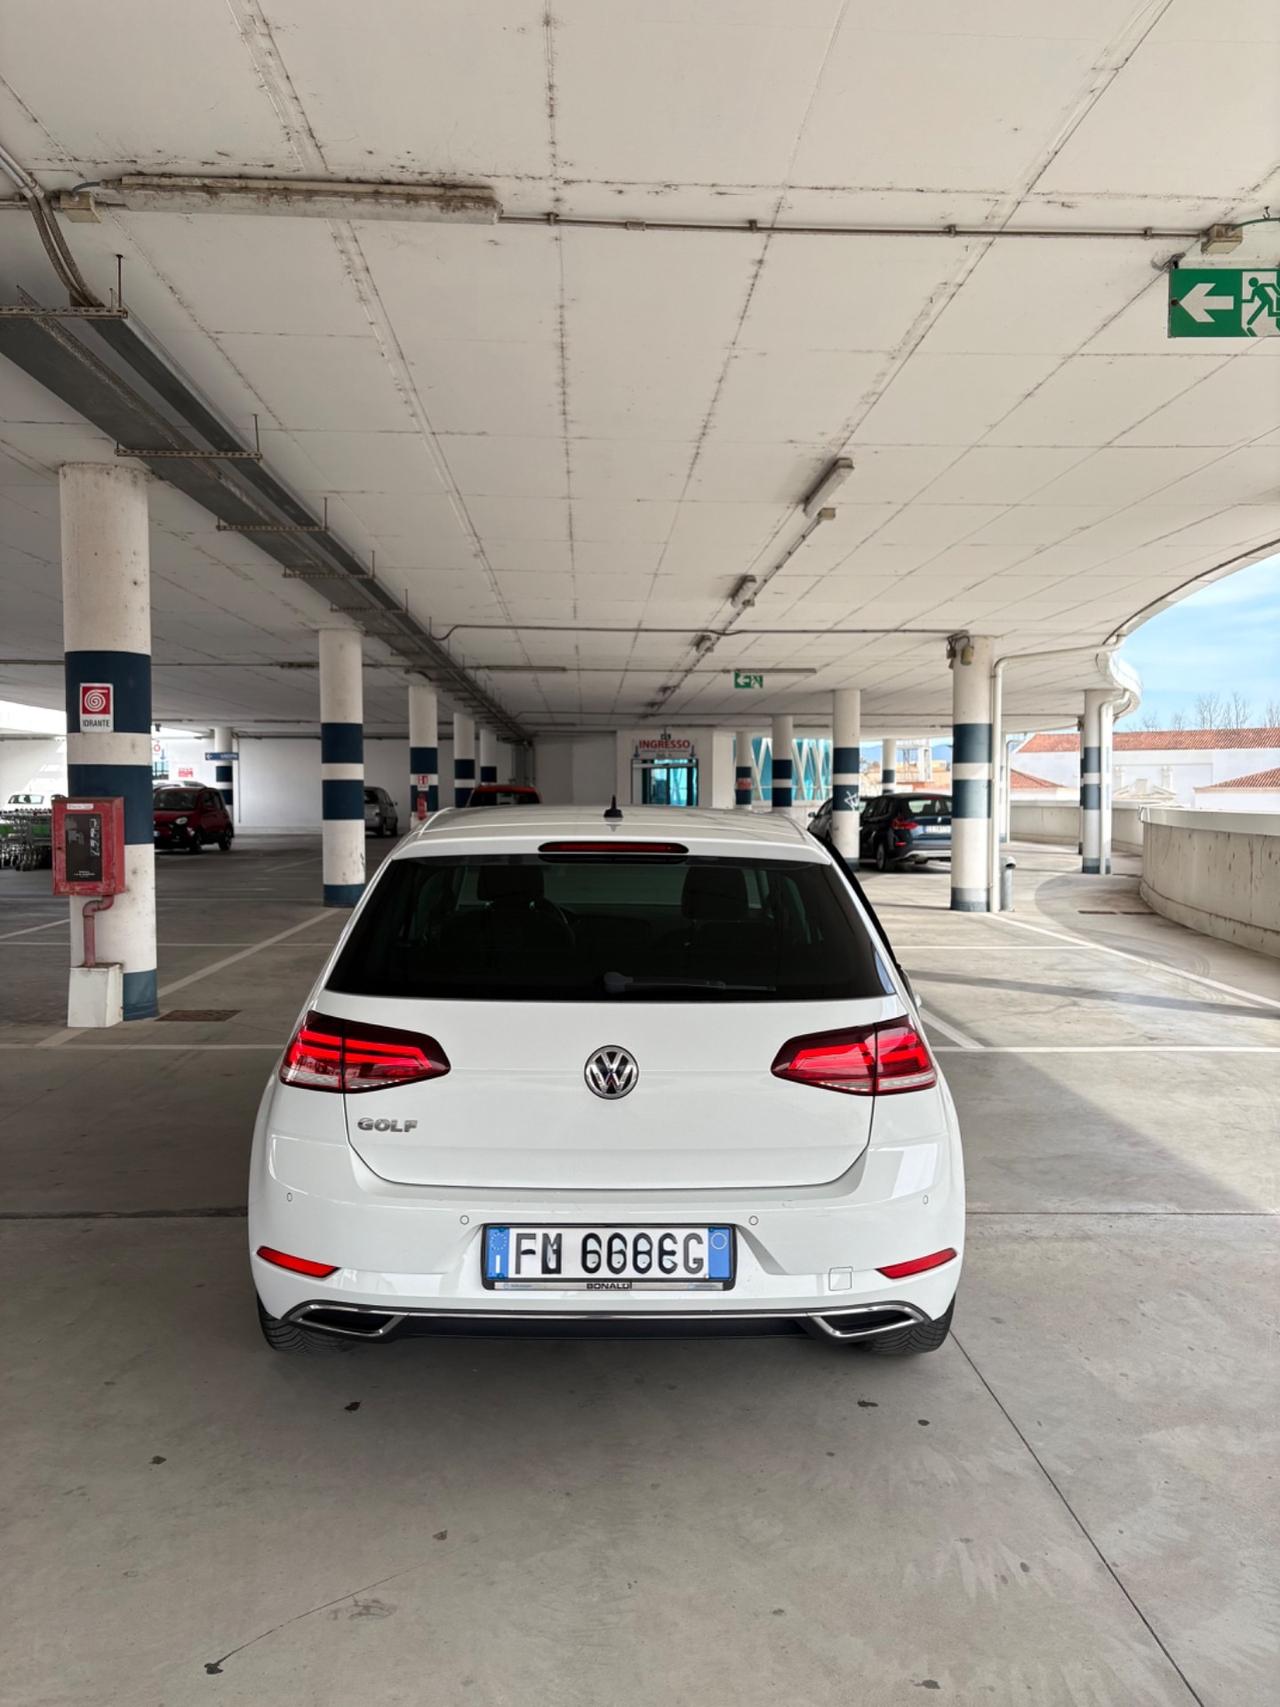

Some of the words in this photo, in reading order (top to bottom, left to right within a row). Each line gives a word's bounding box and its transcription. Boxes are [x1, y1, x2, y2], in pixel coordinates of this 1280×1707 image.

[82, 719, 111, 728] IDRANTE
[639, 739, 690, 749] INGRESSO
[357, 1117, 418, 1132] GOLF
